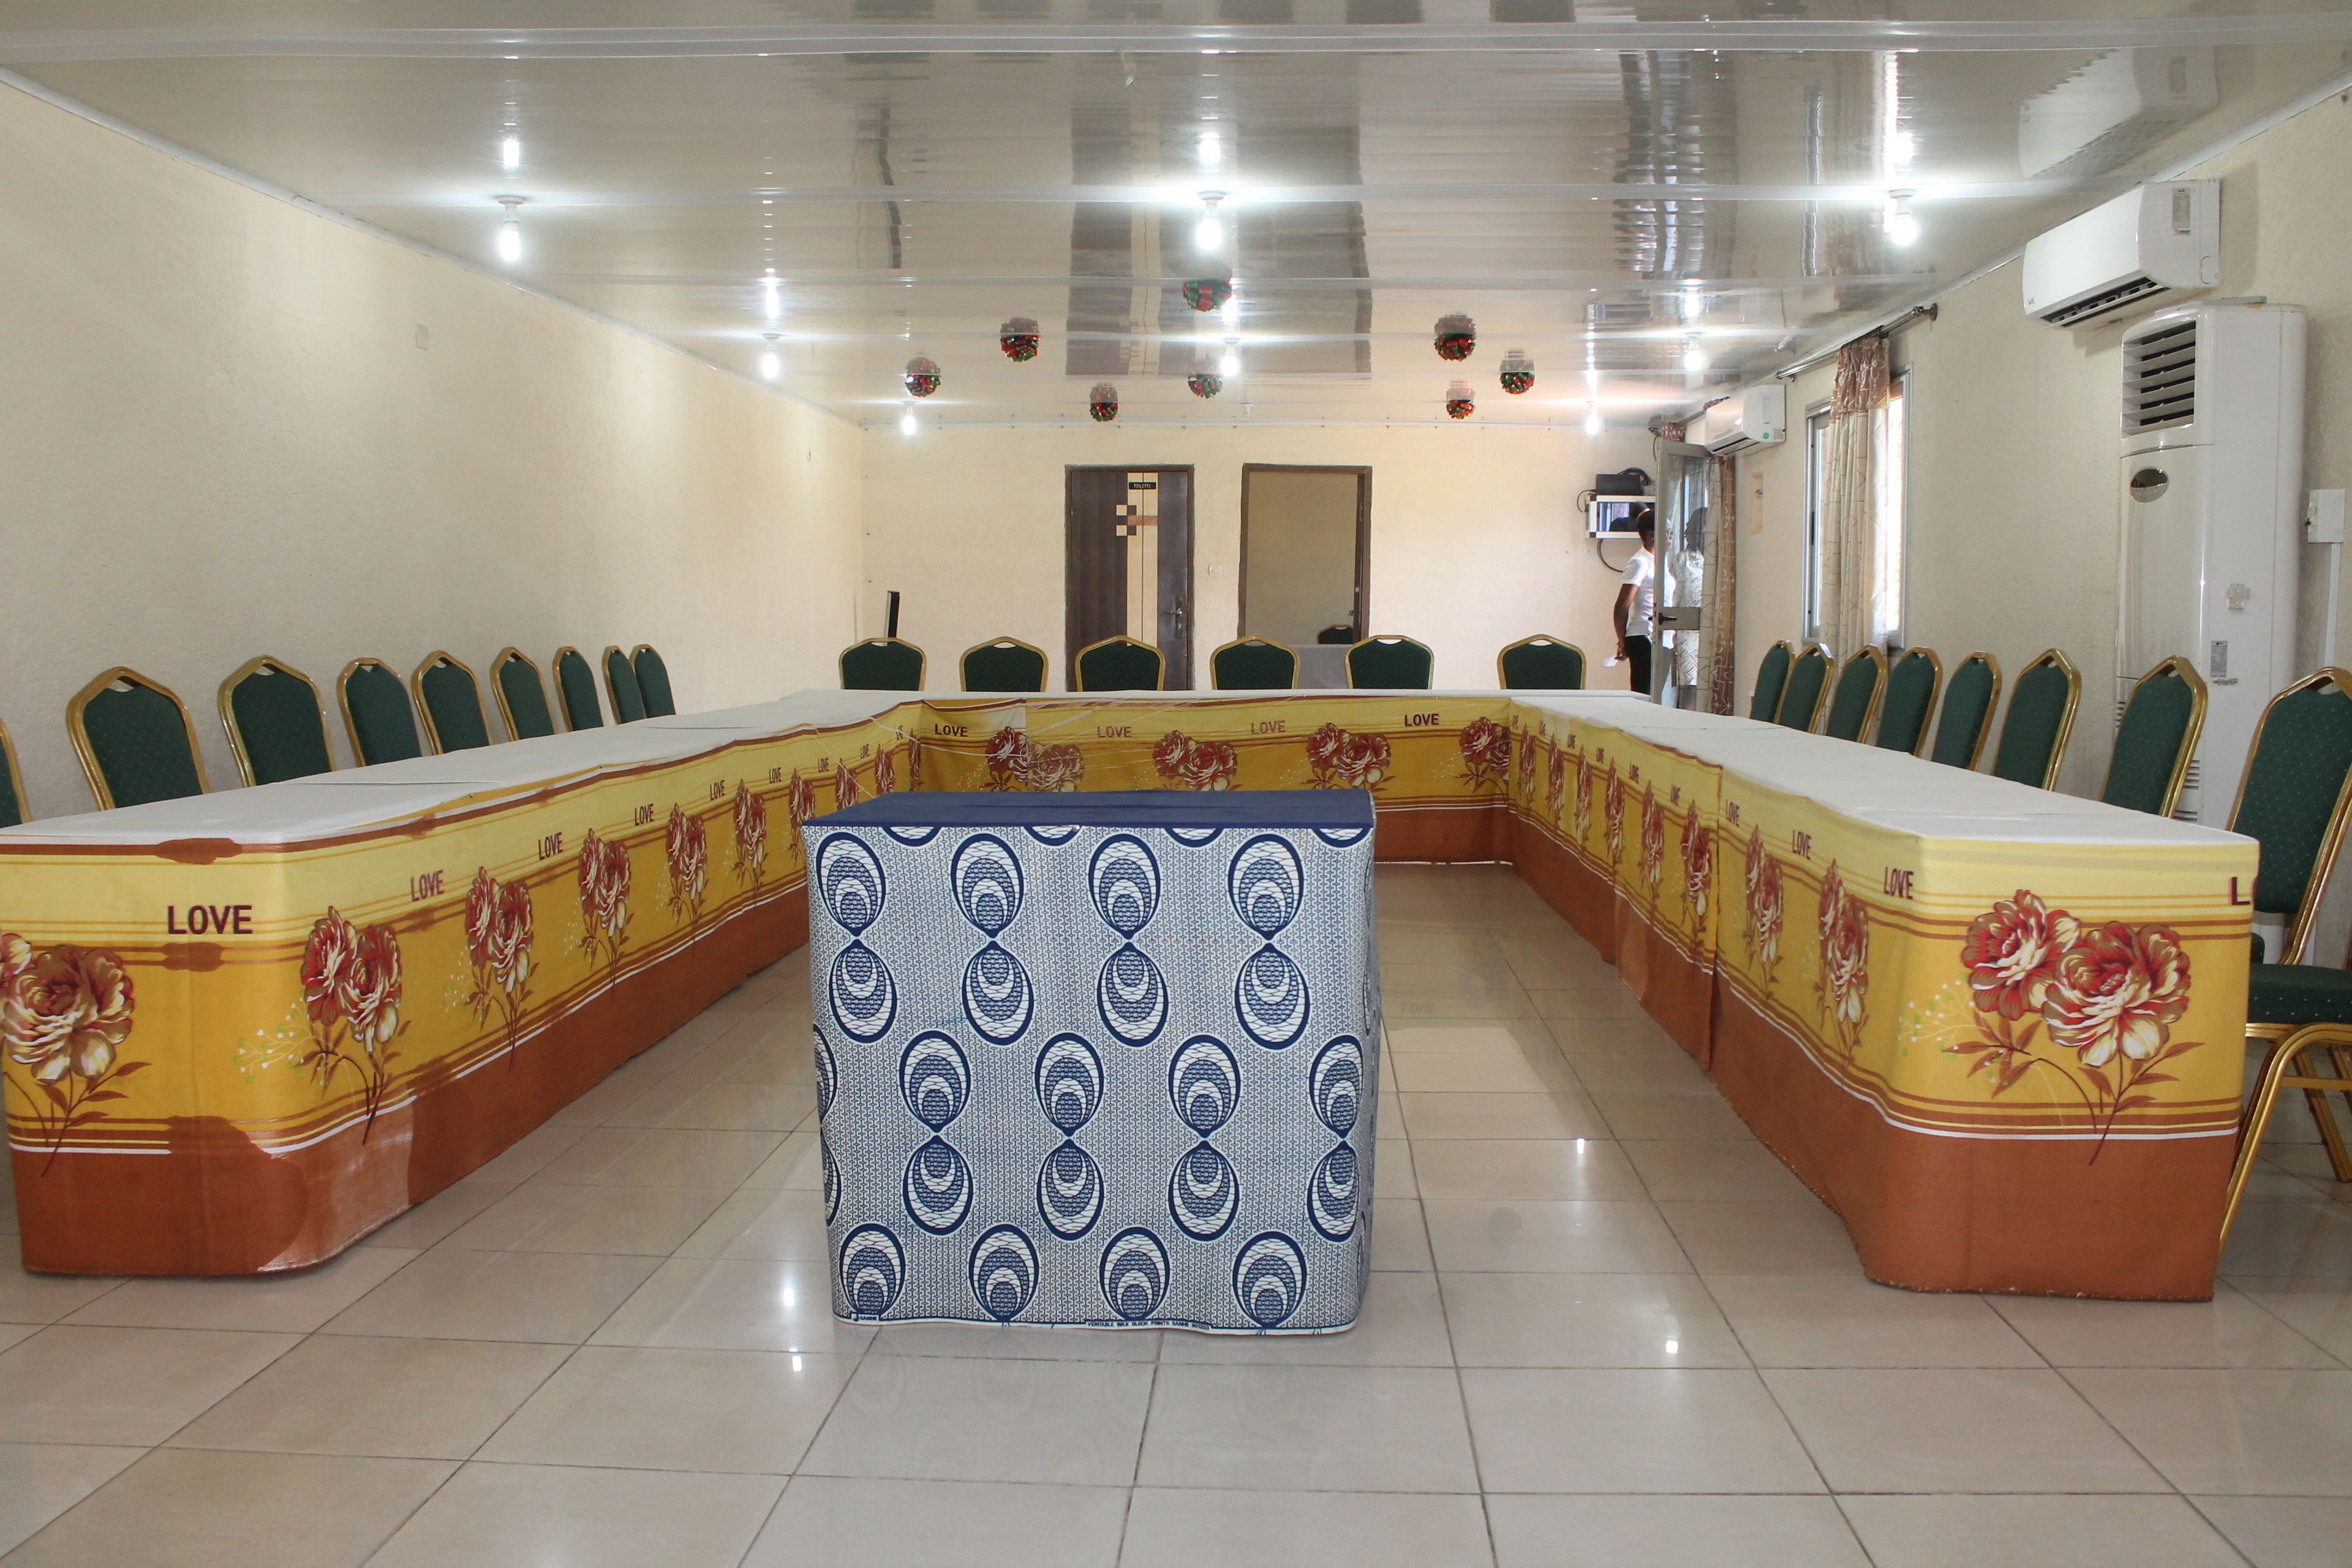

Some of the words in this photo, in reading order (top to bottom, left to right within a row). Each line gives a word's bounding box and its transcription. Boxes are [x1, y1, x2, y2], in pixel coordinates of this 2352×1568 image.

[935, 723, 968, 737] LOVE
[1097, 725, 1132, 739] LOVE
[1251, 720, 1286, 735] LOVE
[1404, 714, 1439, 728] LOVE
[769, 767, 782, 784] LOVE
[818, 758, 829, 772] LOVE
[710, 780, 725, 801] LOVE
[635, 804, 654, 827] LOVE
[1725, 800, 1740, 827] LOVE
[538, 832, 562, 860] LOVE
[1793, 830, 1812, 861] LOVE
[411, 870, 445, 902] LOVE
[1884, 866, 1914, 900] LOVE
[2230, 877, 2256, 905] L
[167, 905, 254, 935] LOVE
